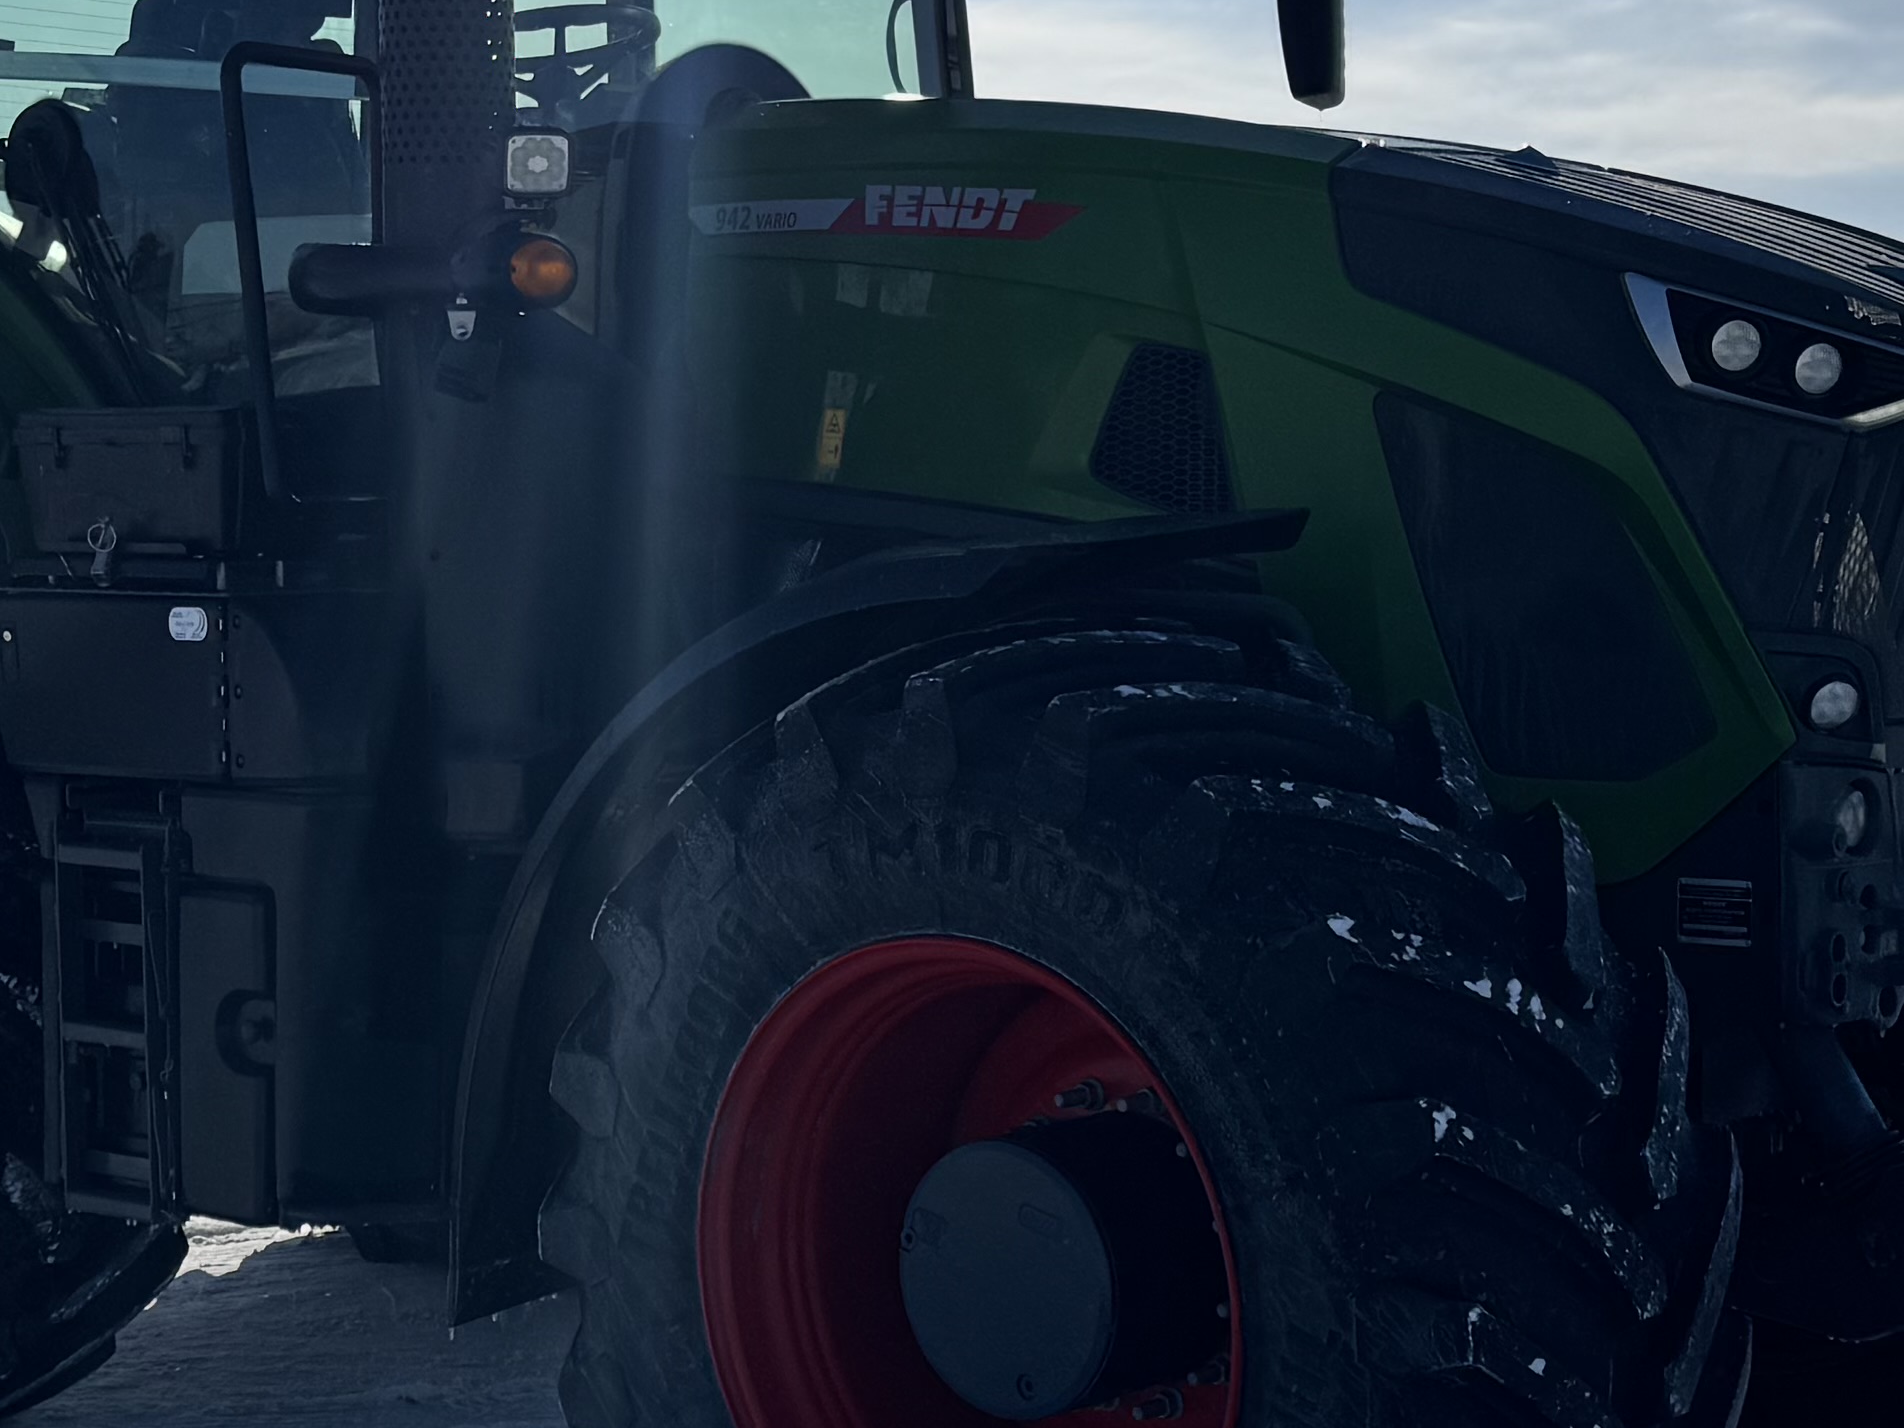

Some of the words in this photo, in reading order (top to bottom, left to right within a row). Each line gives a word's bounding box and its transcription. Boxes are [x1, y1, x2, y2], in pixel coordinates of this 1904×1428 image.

[715, 205, 751, 231] 942
[756, 211, 797, 229] VARIO
[865, 184, 1037, 231] FENDT
